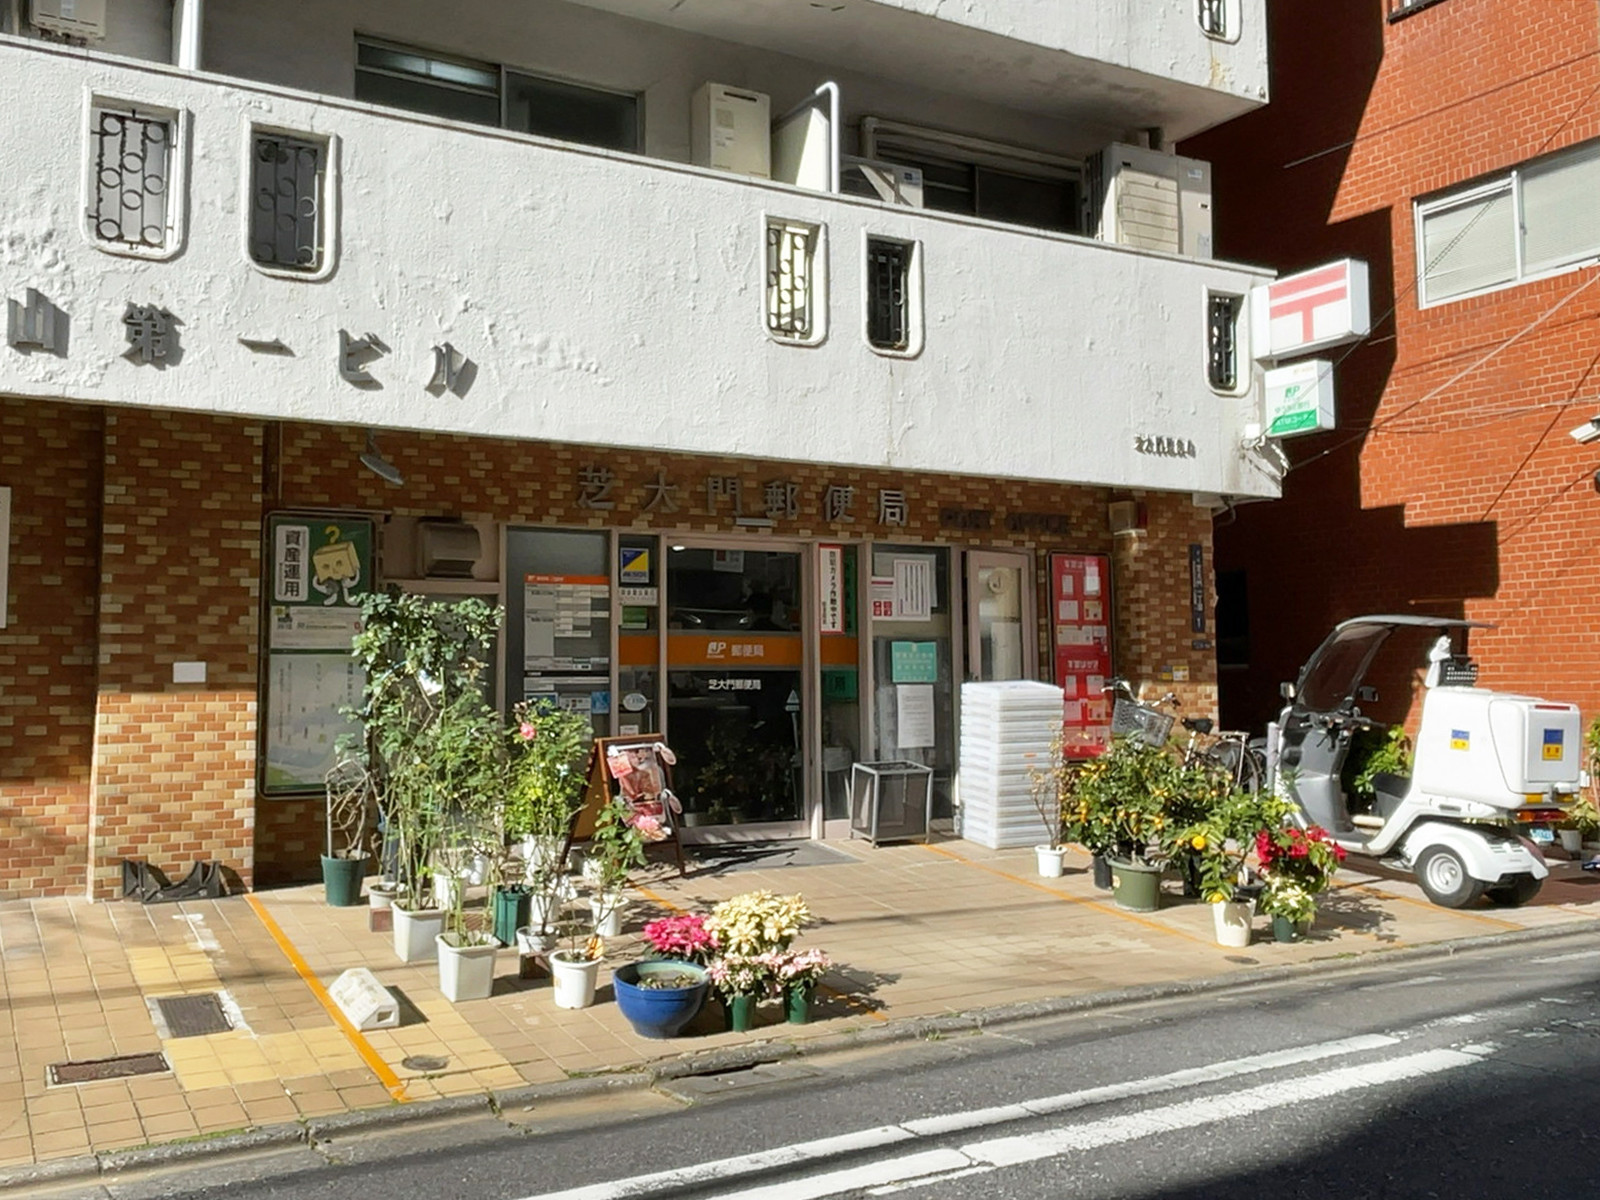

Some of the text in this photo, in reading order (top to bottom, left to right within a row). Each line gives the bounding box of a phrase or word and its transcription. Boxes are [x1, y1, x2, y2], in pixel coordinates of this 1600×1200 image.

[8, 287, 471, 399] 山第一ビル
[577, 465, 909, 527] 芝大門郵便局
[284, 530, 301, 597] 資産運用
